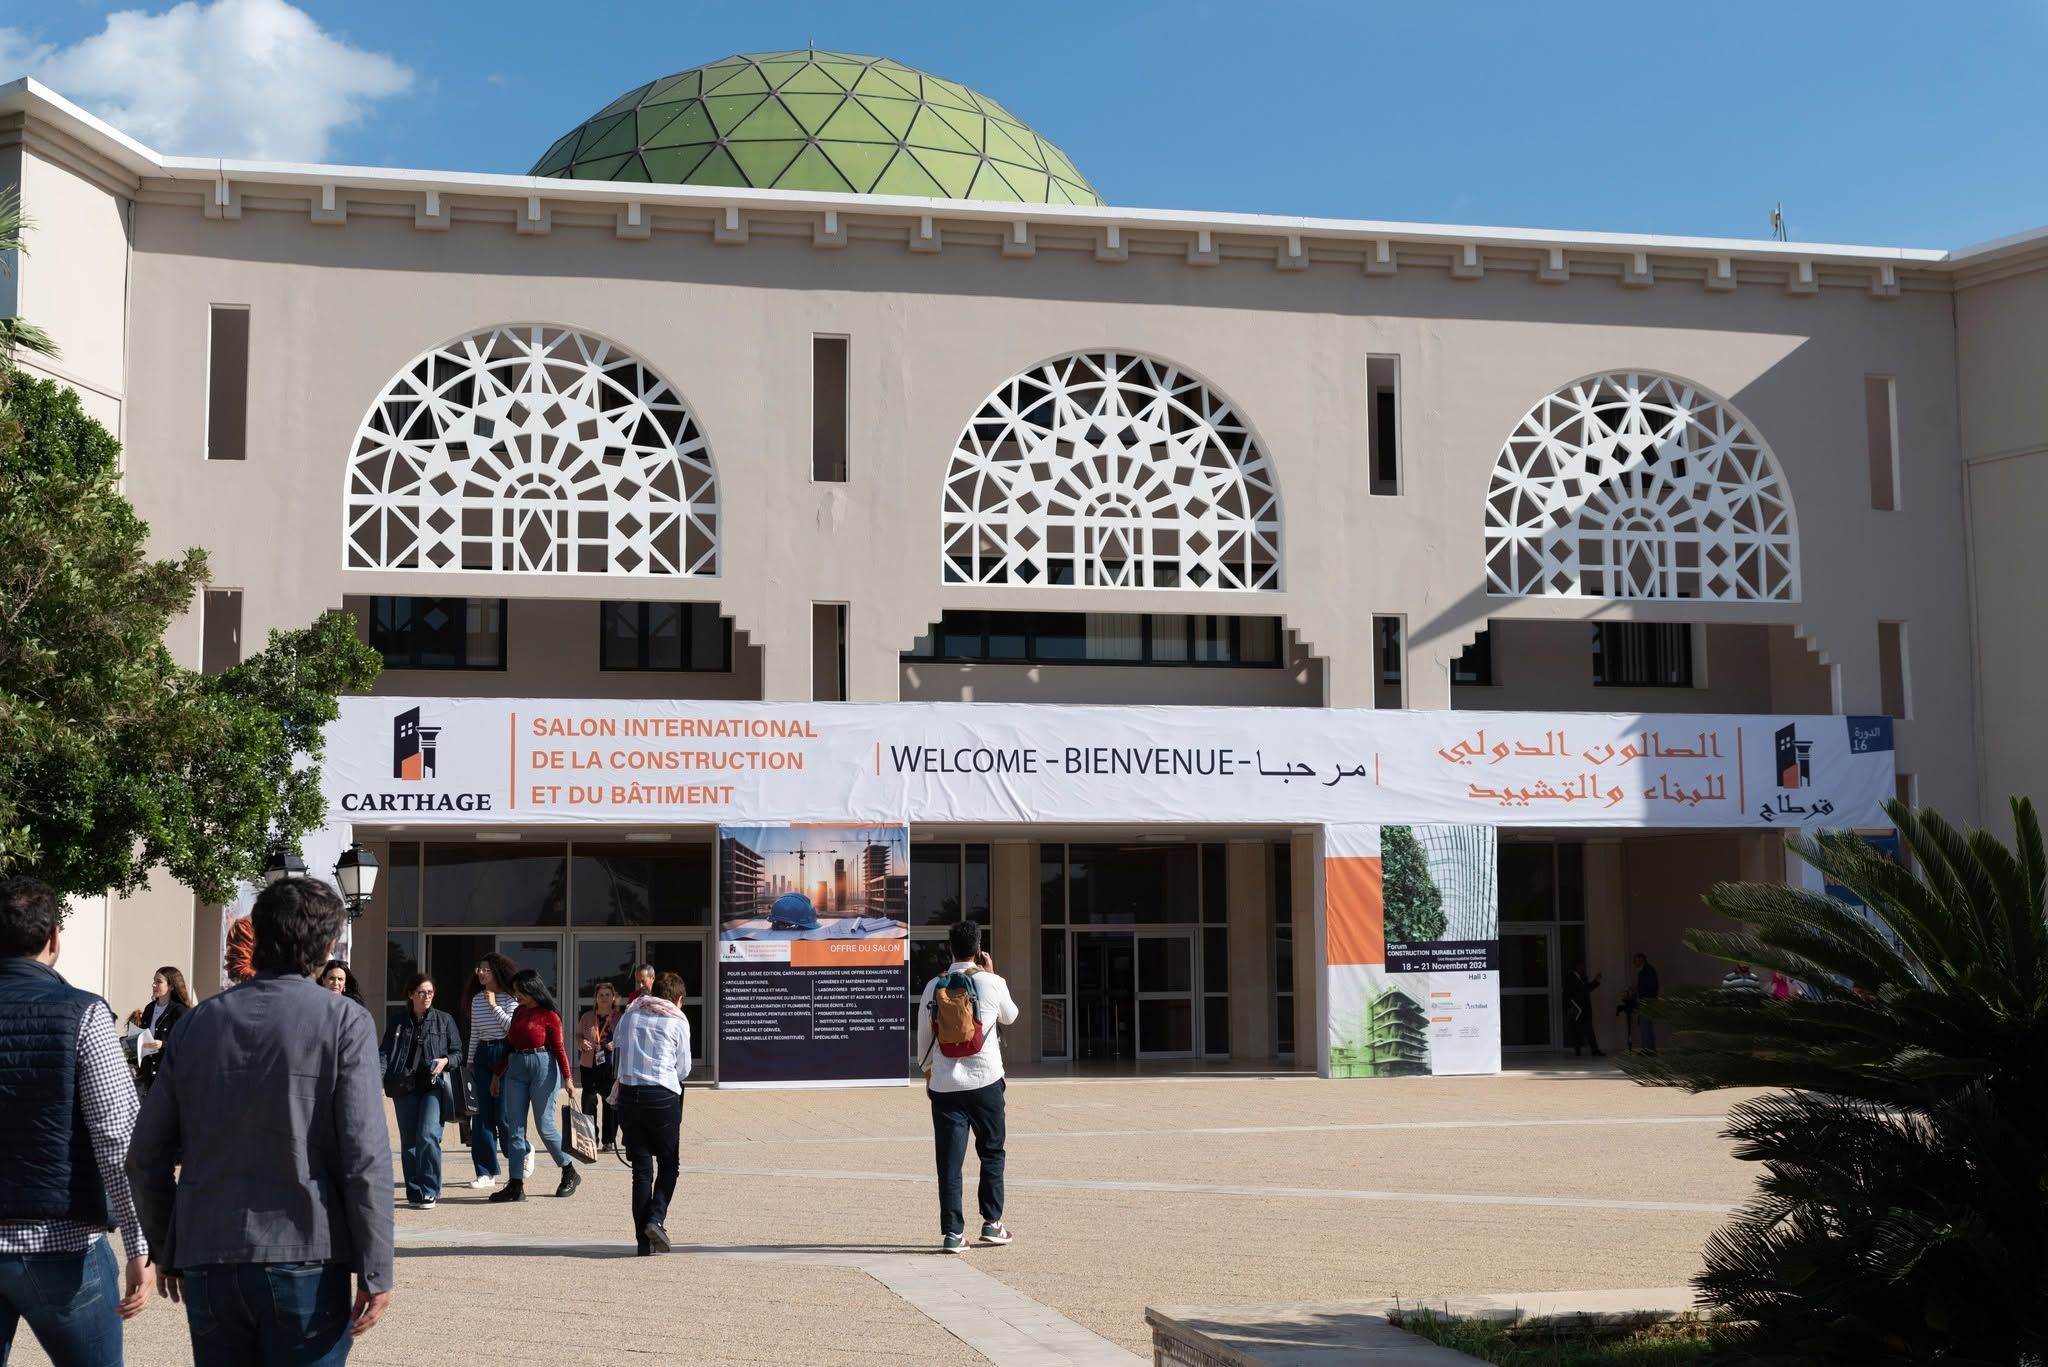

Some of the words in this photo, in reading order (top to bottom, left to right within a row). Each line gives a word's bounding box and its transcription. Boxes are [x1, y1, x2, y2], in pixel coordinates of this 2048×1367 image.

[533, 717, 617, 738] SALON
[624, 718, 819, 739] INTERNATIONAL
[1438, 729, 1575, 765] الدولي
[1583, 731, 1726, 767] الصالون
[1854, 739, 1868, 751] 16
[532, 750, 563, 770] DE
[572, 750, 603, 770] LA
[609, 750, 804, 770] CONSTRUCTION
[1065, 747, 1234, 775] BIENVENUE
[341, 793, 492, 811] CARTHAGE
[532, 786, 561, 805] ET
[568, 786, 604, 805] DU
[611, 781, 734, 806] BÂTIMENT
[1468, 773, 1625, 809] والتشييد
[1643, 773, 1727, 808] للبناء
[1760, 794, 1834, 822] قرطاج
[830, 944, 857, 952] OFFRE
[858, 944, 871, 952] DU
[872, 943, 900, 952] SALON
